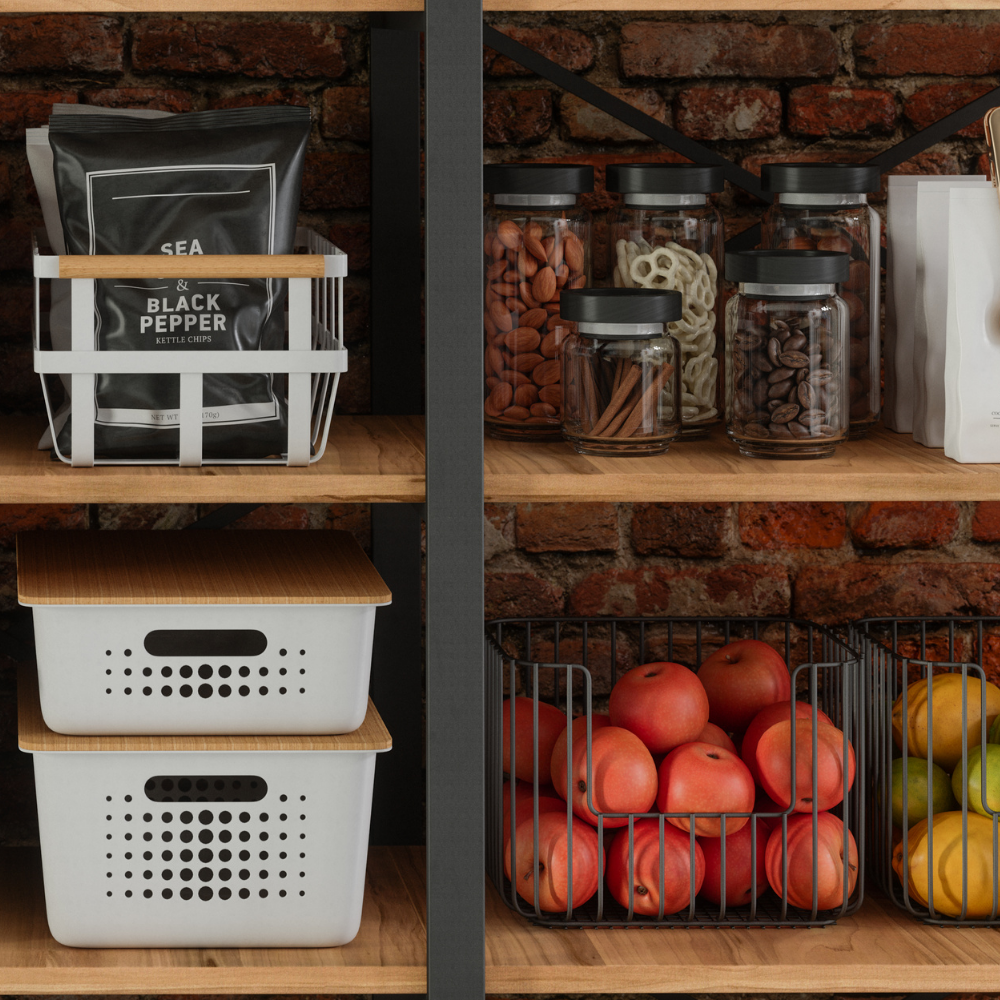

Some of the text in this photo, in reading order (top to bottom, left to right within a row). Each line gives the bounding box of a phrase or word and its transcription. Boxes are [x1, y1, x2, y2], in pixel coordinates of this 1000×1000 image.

[161, 239, 204, 255] SEA
[176, 279, 189, 291] &
[147, 294, 220, 313] BLACK
[140, 314, 226, 334] PEPPER
